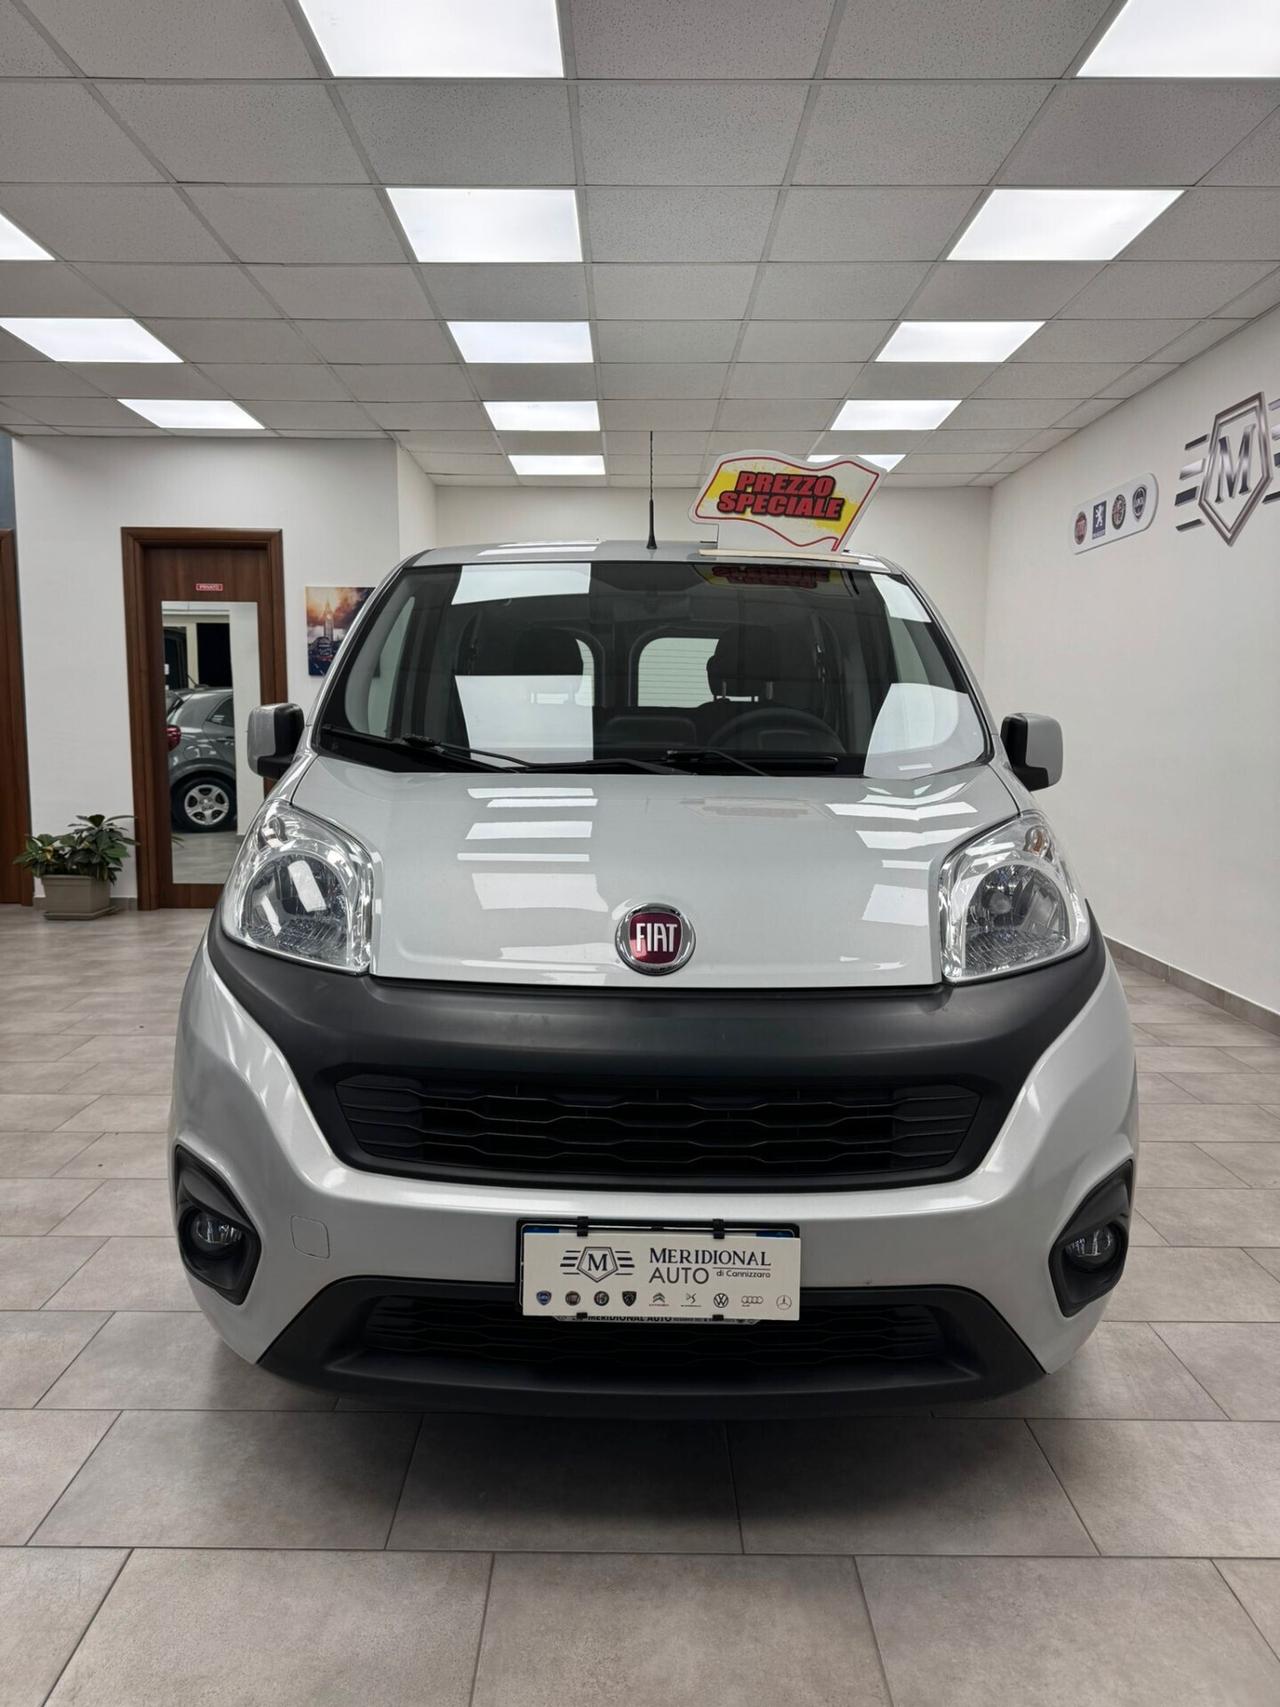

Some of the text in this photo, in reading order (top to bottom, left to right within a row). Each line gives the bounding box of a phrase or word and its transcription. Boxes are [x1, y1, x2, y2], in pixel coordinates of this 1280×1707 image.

[1215, 423, 1256, 504] M
[735, 471, 837, 498] PREZZO
[717, 490, 846, 521] SPECIALE
[636, 922, 678, 953] FIAT
[587, 1253, 608, 1272] M
[649, 1247, 772, 1267] MERIDIONAL
[648, 1266, 710, 1285] AUTO
[716, 1268, 772, 1279] di Cannizzaro
